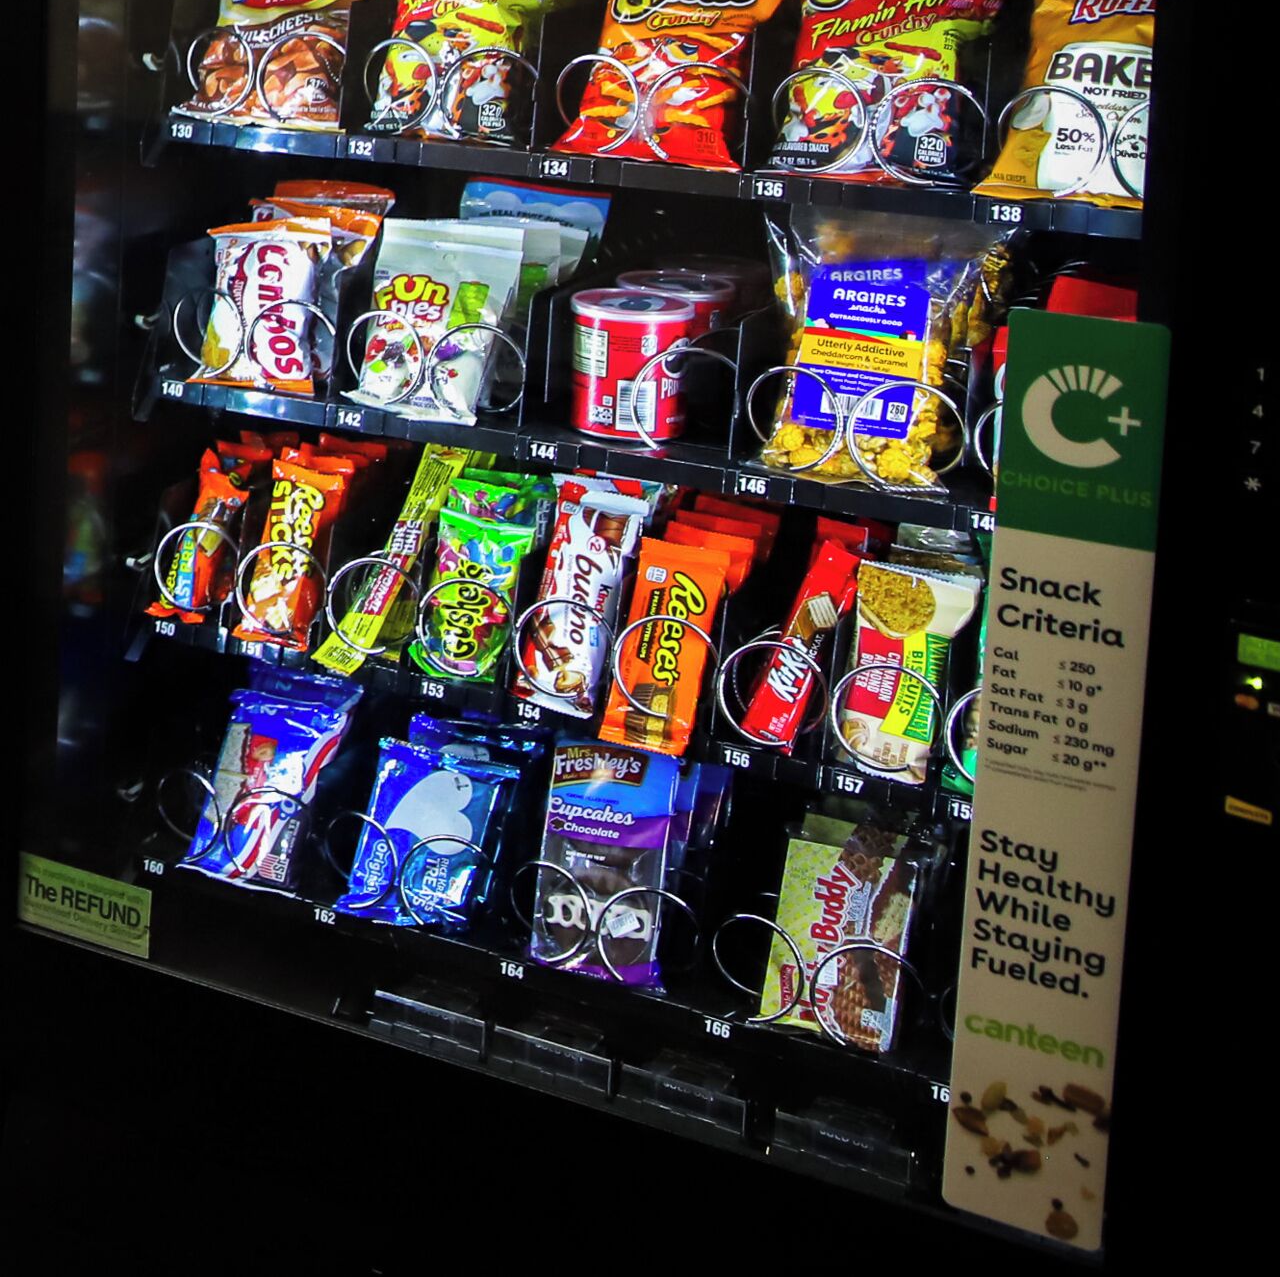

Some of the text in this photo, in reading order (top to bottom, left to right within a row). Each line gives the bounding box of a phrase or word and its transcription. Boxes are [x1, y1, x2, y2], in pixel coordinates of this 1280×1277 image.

[647, 9, 721, 30] Crunchy
[811, 0, 900, 50] Flamin'
[855, 13, 937, 46] Crunchy
[1083, 86, 1148, 100] NOT FRIED
[480, 103, 503, 117] 320
[170, 124, 192, 139] 130
[696, 130, 716, 144] 310
[1056, 127, 1096, 144] 50%
[348, 141, 373, 157] 132
[919, 137, 944, 152] 320
[543, 160, 568, 178] 134
[756, 181, 784, 198] 136
[991, 206, 1022, 222] 138
[848, 304, 887, 315] snacks
[829, 312, 881, 325] OUTRAGEOUSLY
[817, 339, 905, 358] Utterly Addictive
[811, 348, 908, 369] Cheddarcorn Caramel
[162, 382, 183, 397] 140
[339, 411, 361, 427] 142
[530, 444, 555, 460] 144
[739, 477, 766, 494] 146
[1000, 470, 1153, 507] CHOICE PLUS
[1000, 567, 1102, 608] Snack
[155, 620, 176, 636] 150
[997, 604, 1125, 649] Criteria
[241, 643, 262, 655] 151
[993, 647, 1019, 661] Cal
[992, 665, 1016, 679] Fat
[1070, 661, 1096, 675] 250
[421, 681, 445, 698] 153
[991, 683, 1044, 703] Sat Fat
[1068, 680, 1082, 692] 10
[516, 702, 541, 720] 154
[989, 701, 1059, 725] Trans Fat
[988, 719, 1039, 740] Sodium
[566, 746, 594, 759] Mrs.
[987, 737, 1029, 756] Sugar
[1064, 735, 1115, 757] 230 mg
[553, 753, 642, 777] Freshley's
[723, 749, 750, 767] 156
[1062, 753, 1080, 766] 20
[836, 775, 864, 794] 157
[548, 796, 636, 826] Cupcakes
[563, 822, 620, 839] Chocolate
[980, 829, 1059, 872] Stay
[143, 859, 164, 875] 160
[977, 859, 1117, 918] Healthy
[26, 873, 58, 902] The
[61, 885, 142, 928] REFUND
[810, 863, 862, 944] Buddy
[313, 908, 336, 925] 162
[975, 888, 1072, 932] While
[972, 918, 1107, 978] Staying
[500, 962, 525, 979] 164
[970, 947, 1090, 999] Fueled.
[704, 1020, 730, 1039] 166
[964, 1013, 1107, 1069] canteen
